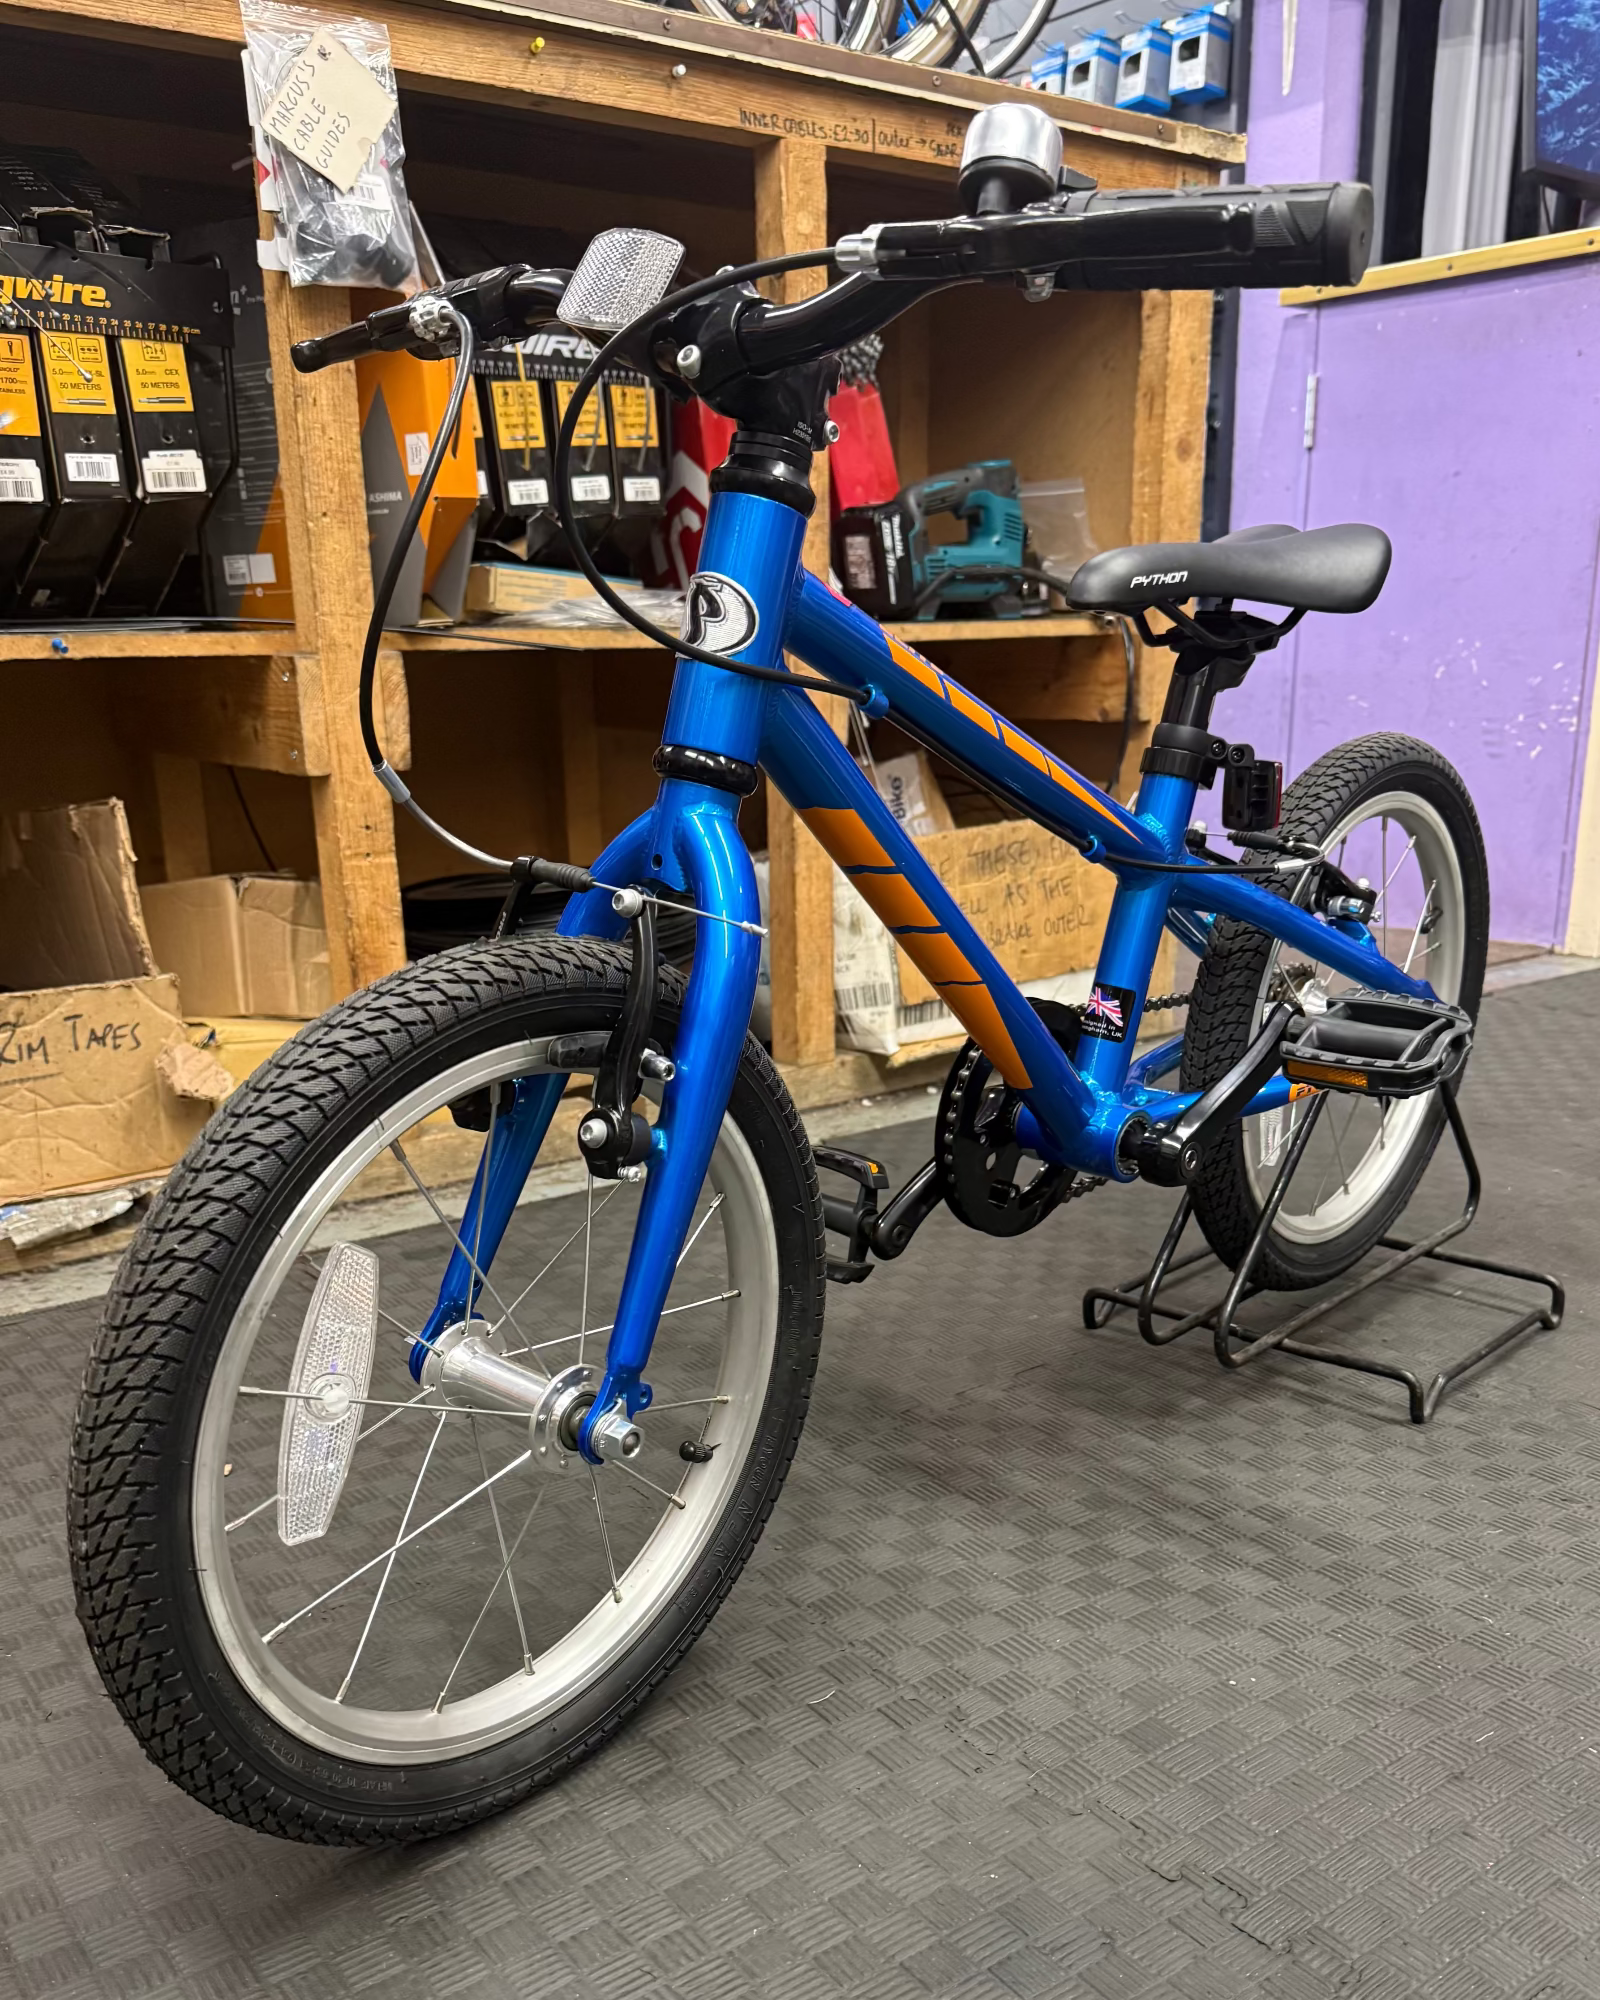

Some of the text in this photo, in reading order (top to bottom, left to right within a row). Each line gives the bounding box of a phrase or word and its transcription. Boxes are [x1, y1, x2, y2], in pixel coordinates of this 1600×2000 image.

[293, 98, 326, 151] CABLE
[739, 107, 781, 131] INNER
[315, 112, 350, 169] GUIDES
[164, 368, 180, 376] CEX
[60, 382, 102, 391] 50 METERS
[151, 382, 180, 390] METERS
[369, 490, 402, 503] ASHIMA
[1130, 571, 1188, 588] PYTHON
[1043, 904, 1089, 936] OUTER
[62, 1013, 141, 1052] TAPES
[1111, 1029, 1123, 1038] UK
